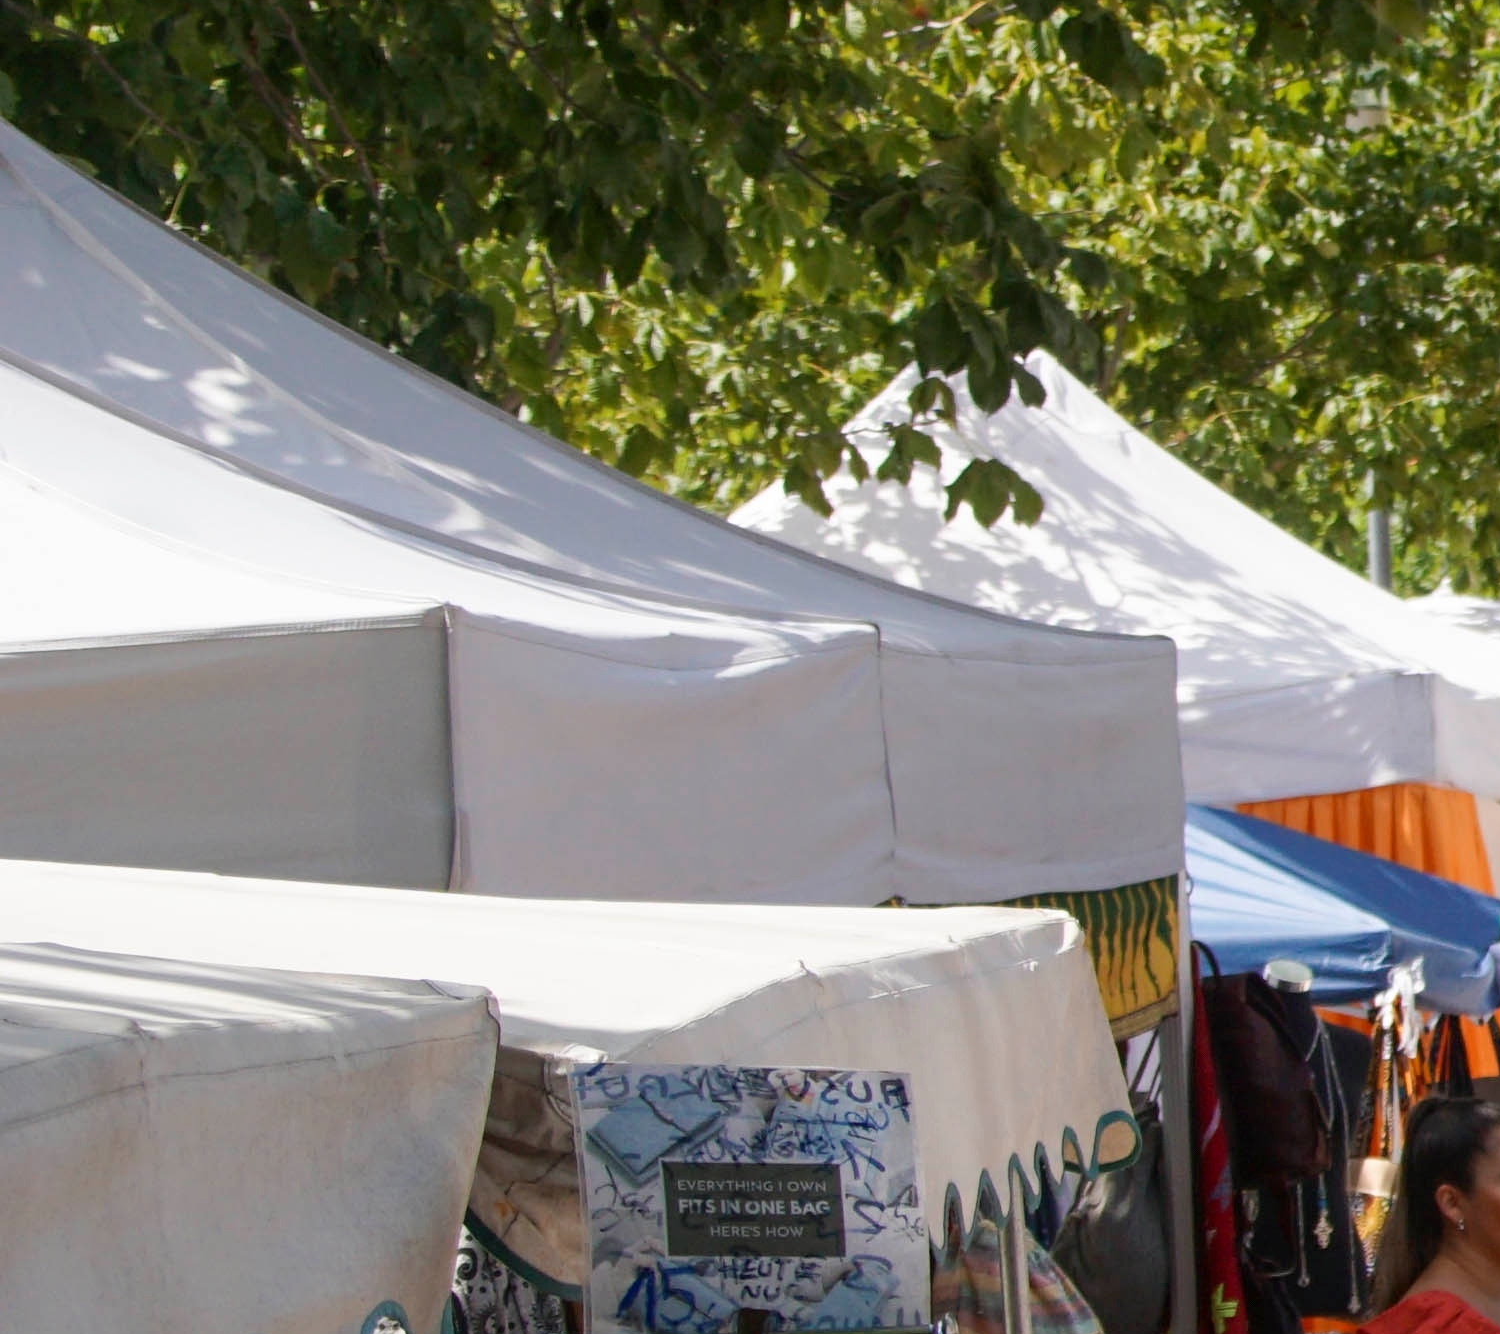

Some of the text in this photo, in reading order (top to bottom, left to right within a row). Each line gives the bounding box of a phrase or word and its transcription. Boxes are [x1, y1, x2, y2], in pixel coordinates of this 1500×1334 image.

[677, 1179, 774, 1193] EVERYTHING
[785, 1179, 828, 1192] OWN
[677, 1198, 831, 1215] FITS IN ONE BAG
[710, 1225, 804, 1239] HERE'S HOW
